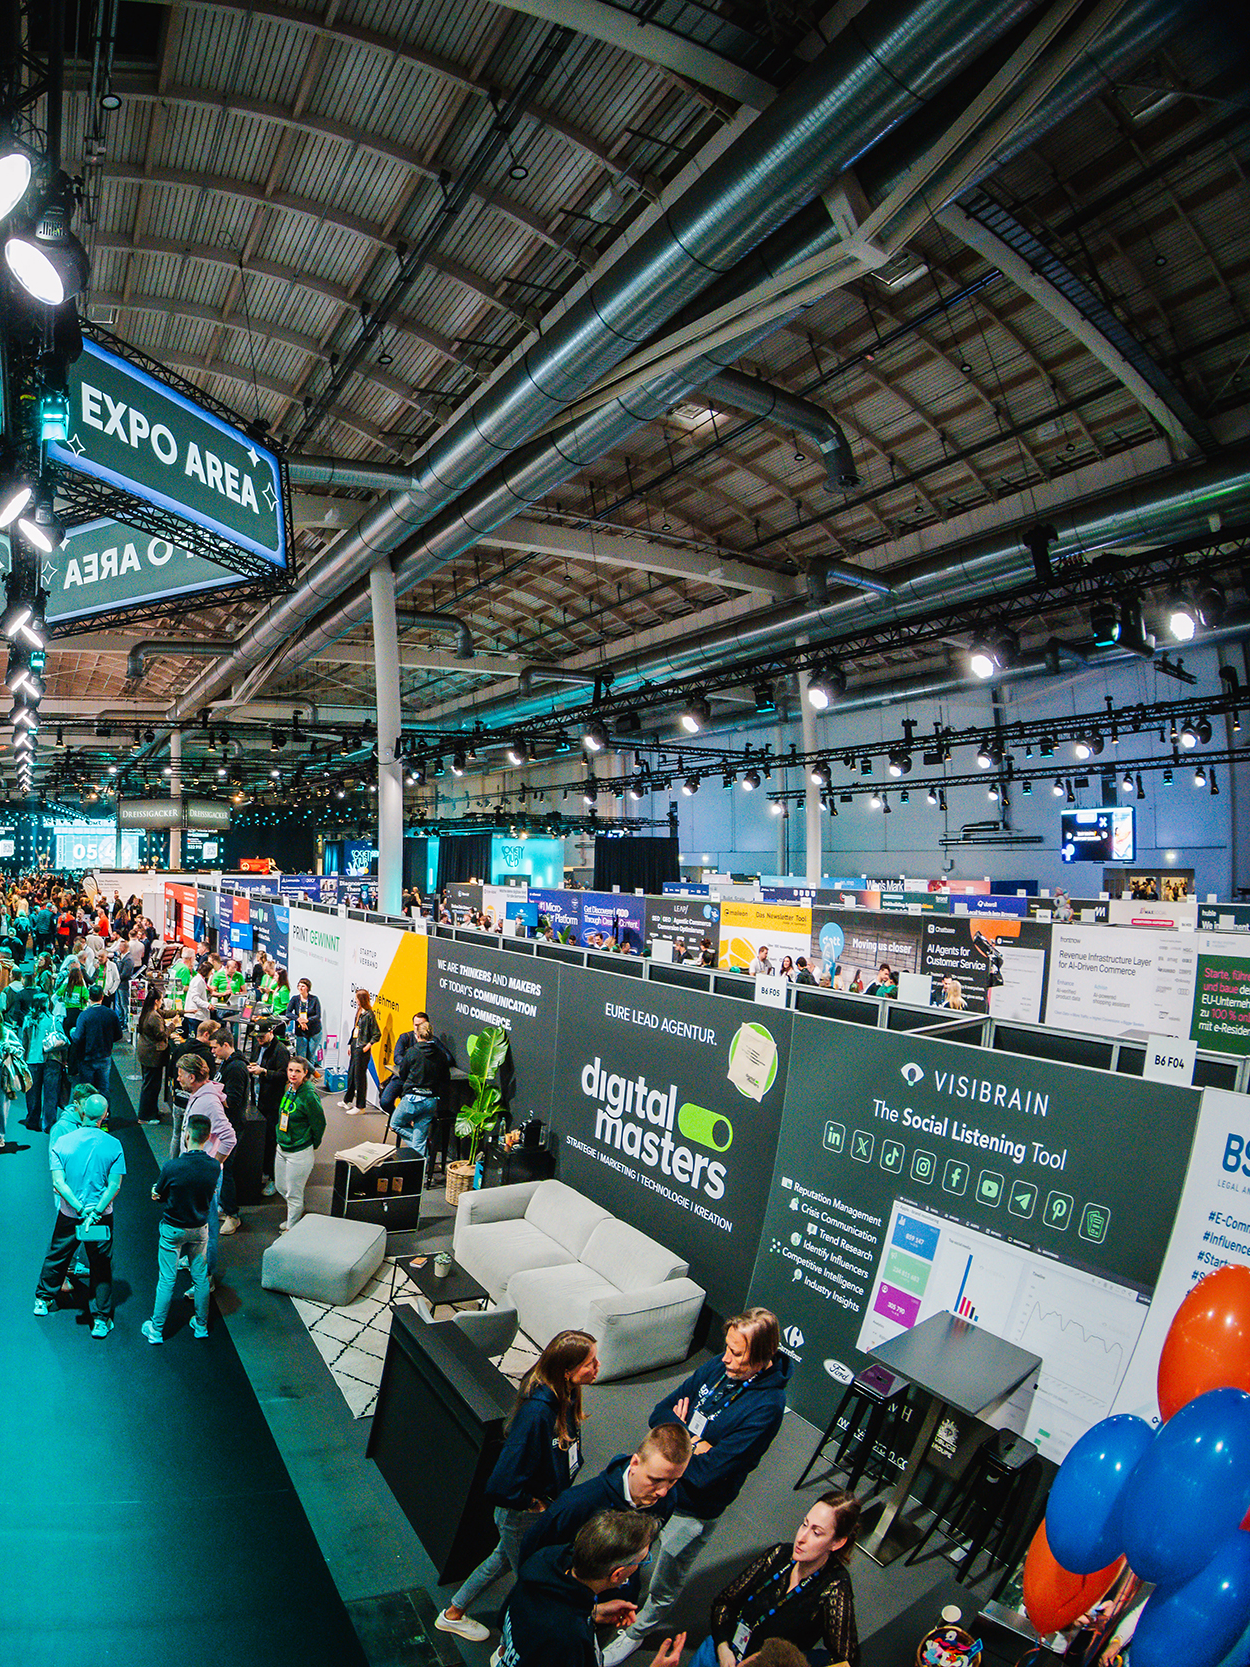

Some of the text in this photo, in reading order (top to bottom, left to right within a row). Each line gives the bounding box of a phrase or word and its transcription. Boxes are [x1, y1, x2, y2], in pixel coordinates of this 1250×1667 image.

[80, 381, 260, 515] EXPO AREA
[122, 809, 178, 818] DREISSIGACKER
[189, 809, 229, 819] DREISSIGACKER
[756, 911, 766, 919] Das
[766, 912, 796, 922] Newsletter
[796, 914, 807, 922] Tool
[293, 925, 309, 942] PRINT
[310, 930, 340, 952] GEWINNT
[852, 938, 912, 954] Moving us closer
[359, 948, 377, 958] STARTUP
[927, 943, 970, 957] AI Agents for
[1059, 950, 1152, 968] Revenue Infrastructure Layer
[359, 957, 378, 969] VERBAND
[926, 956, 986, 971] Customer Service
[1058, 960, 1136, 976] for AI-Driven Commerce
[438, 959, 542, 996] WE ARE THINKERS AND MAKERS
[1204, 967, 1230, 981] Starte,
[439, 978, 537, 1018] OF TODAY'S COMMUNICATION
[761, 987, 780, 997] B6 F05
[1203, 982, 1238, 995] und baue
[455, 1002, 512, 1031] AND COMMERCE.
[605, 1002, 718, 1046] EURE LEAD AGENTUR.
[1200, 1008, 1237, 1020] zu 100 %
[1199, 1021, 1212, 1031] mit
[1154, 1054, 1185, 1069] B6 F04
[581, 1057, 677, 1131] digital
[935, 1070, 1050, 1117] VISIBRAIN
[873, 1099, 1067, 1171] The Social Listening Tool
[594, 1108, 727, 1199] masters
[566, 1135, 733, 1232] STRATEGIE MARKETING TECHNOLOGIE KREATION
[1217, 1179, 1239, 1193] LEGAL
[794, 1182, 882, 1227] Reputation Management
[801, 1203, 877, 1244] Crisis Communication
[819, 1228, 873, 1261] Trend Research
[803, 1240, 869, 1279] Identify Influencers
[782, 1247, 864, 1296] Competitive Intelligence
[804, 1276, 860, 1312] Industry Insights
[829, 1362, 850, 1382] Ford
